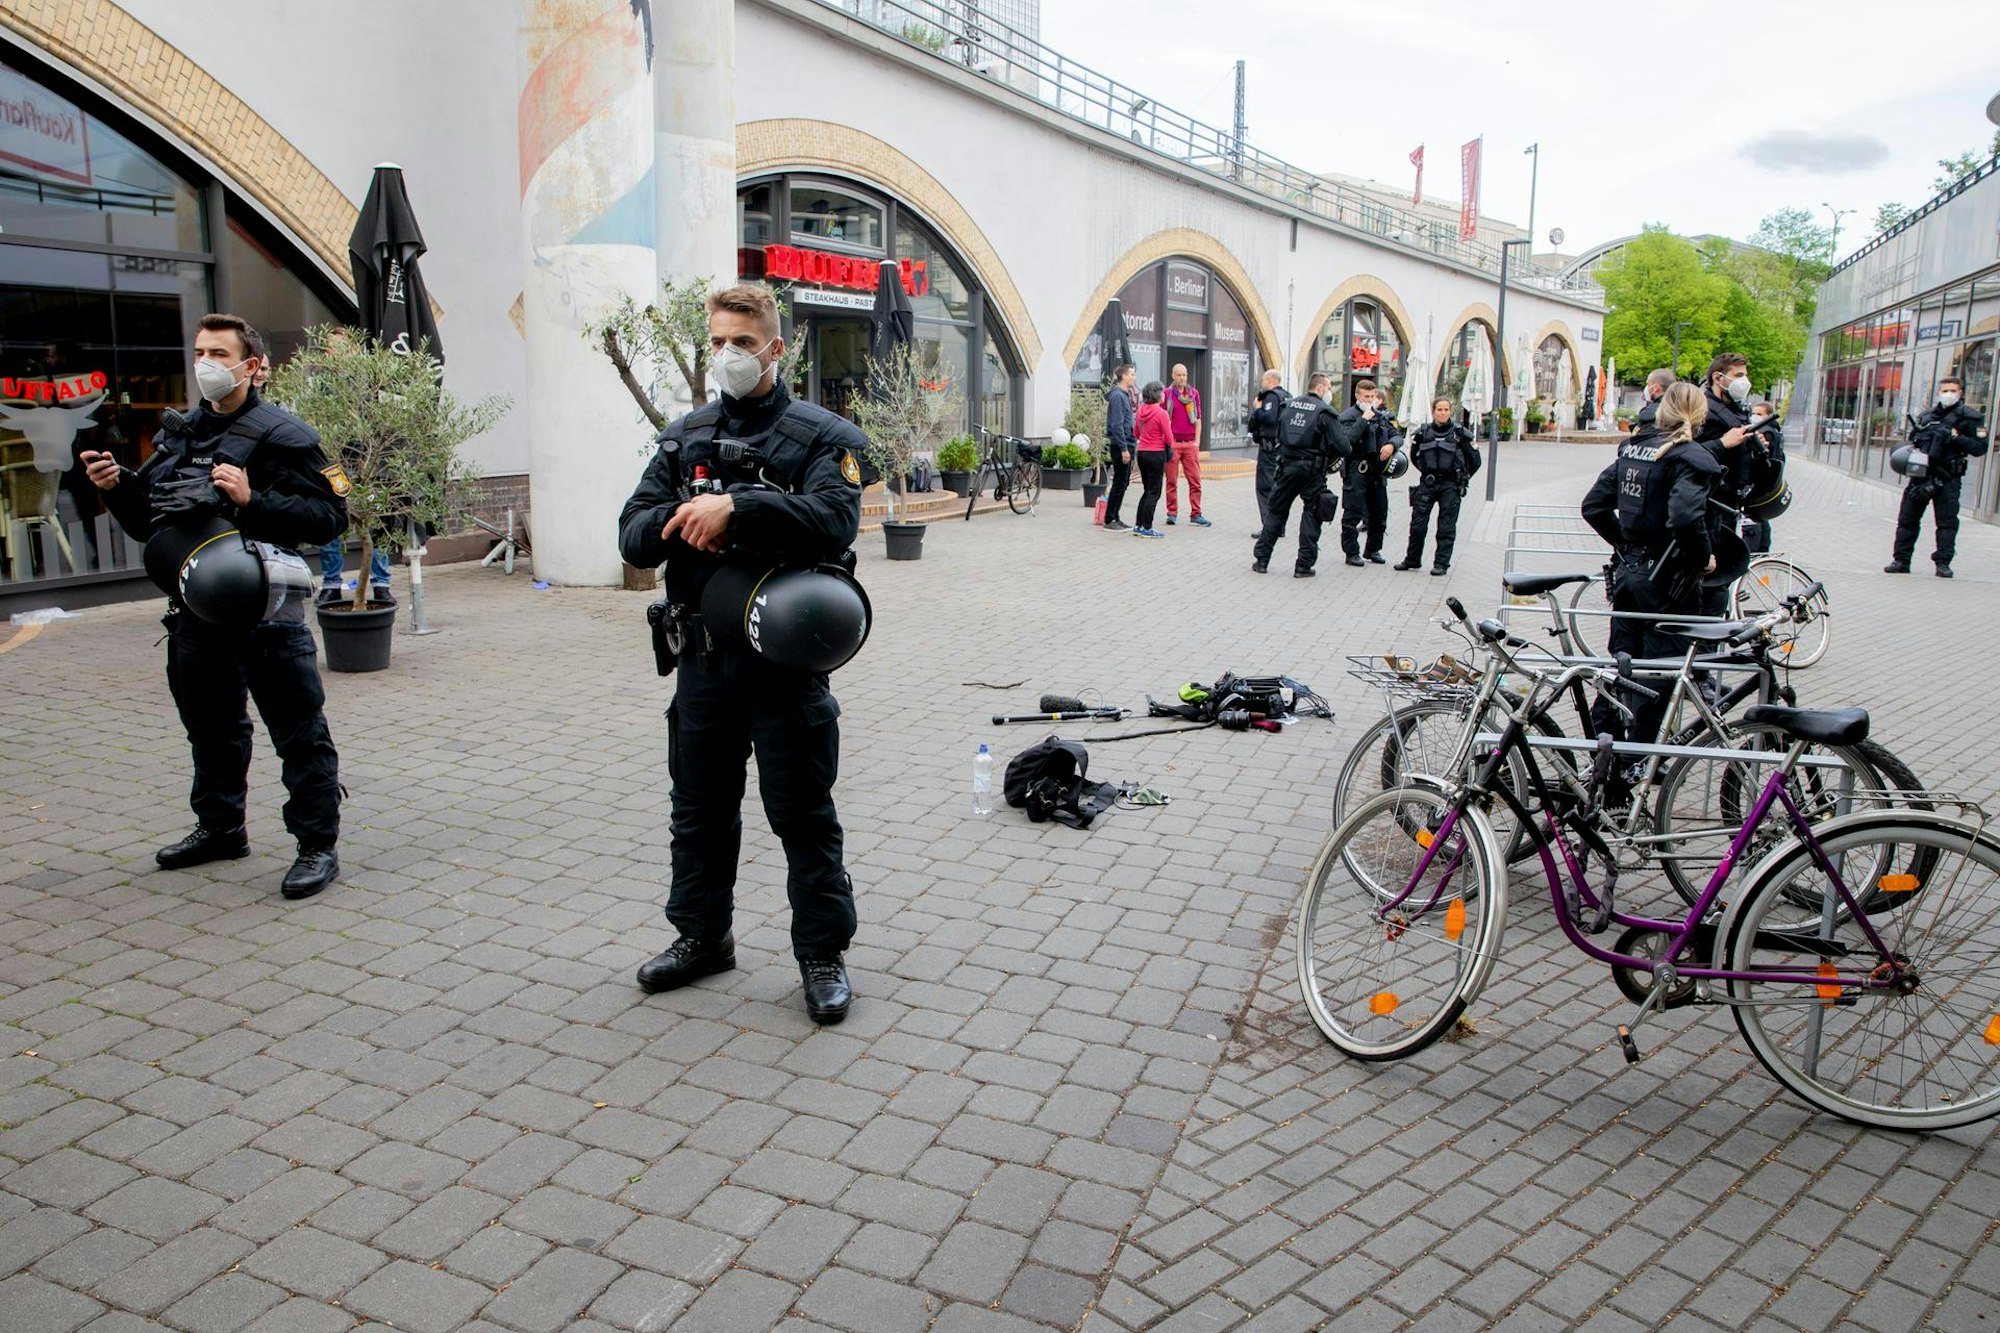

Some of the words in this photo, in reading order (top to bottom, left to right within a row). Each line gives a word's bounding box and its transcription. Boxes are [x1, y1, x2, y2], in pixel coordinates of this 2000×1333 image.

[764, 244, 928, 297] BUFFLO
[1174, 276, 1205, 297] Berliner
[804, 292, 849, 305] STEAKHAUS
[855, 298, 874, 307] PAST
[1122, 311, 1154, 331] torrad
[1214, 322, 1245, 342] Museum
[1290, 401, 1316, 411] POLIZEI
[1622, 444, 1658, 462] POLIZE
[1626, 468, 1639, 482] BY
[1621, 481, 1642, 498] 1422
[748, 594, 768, 653] 1422
